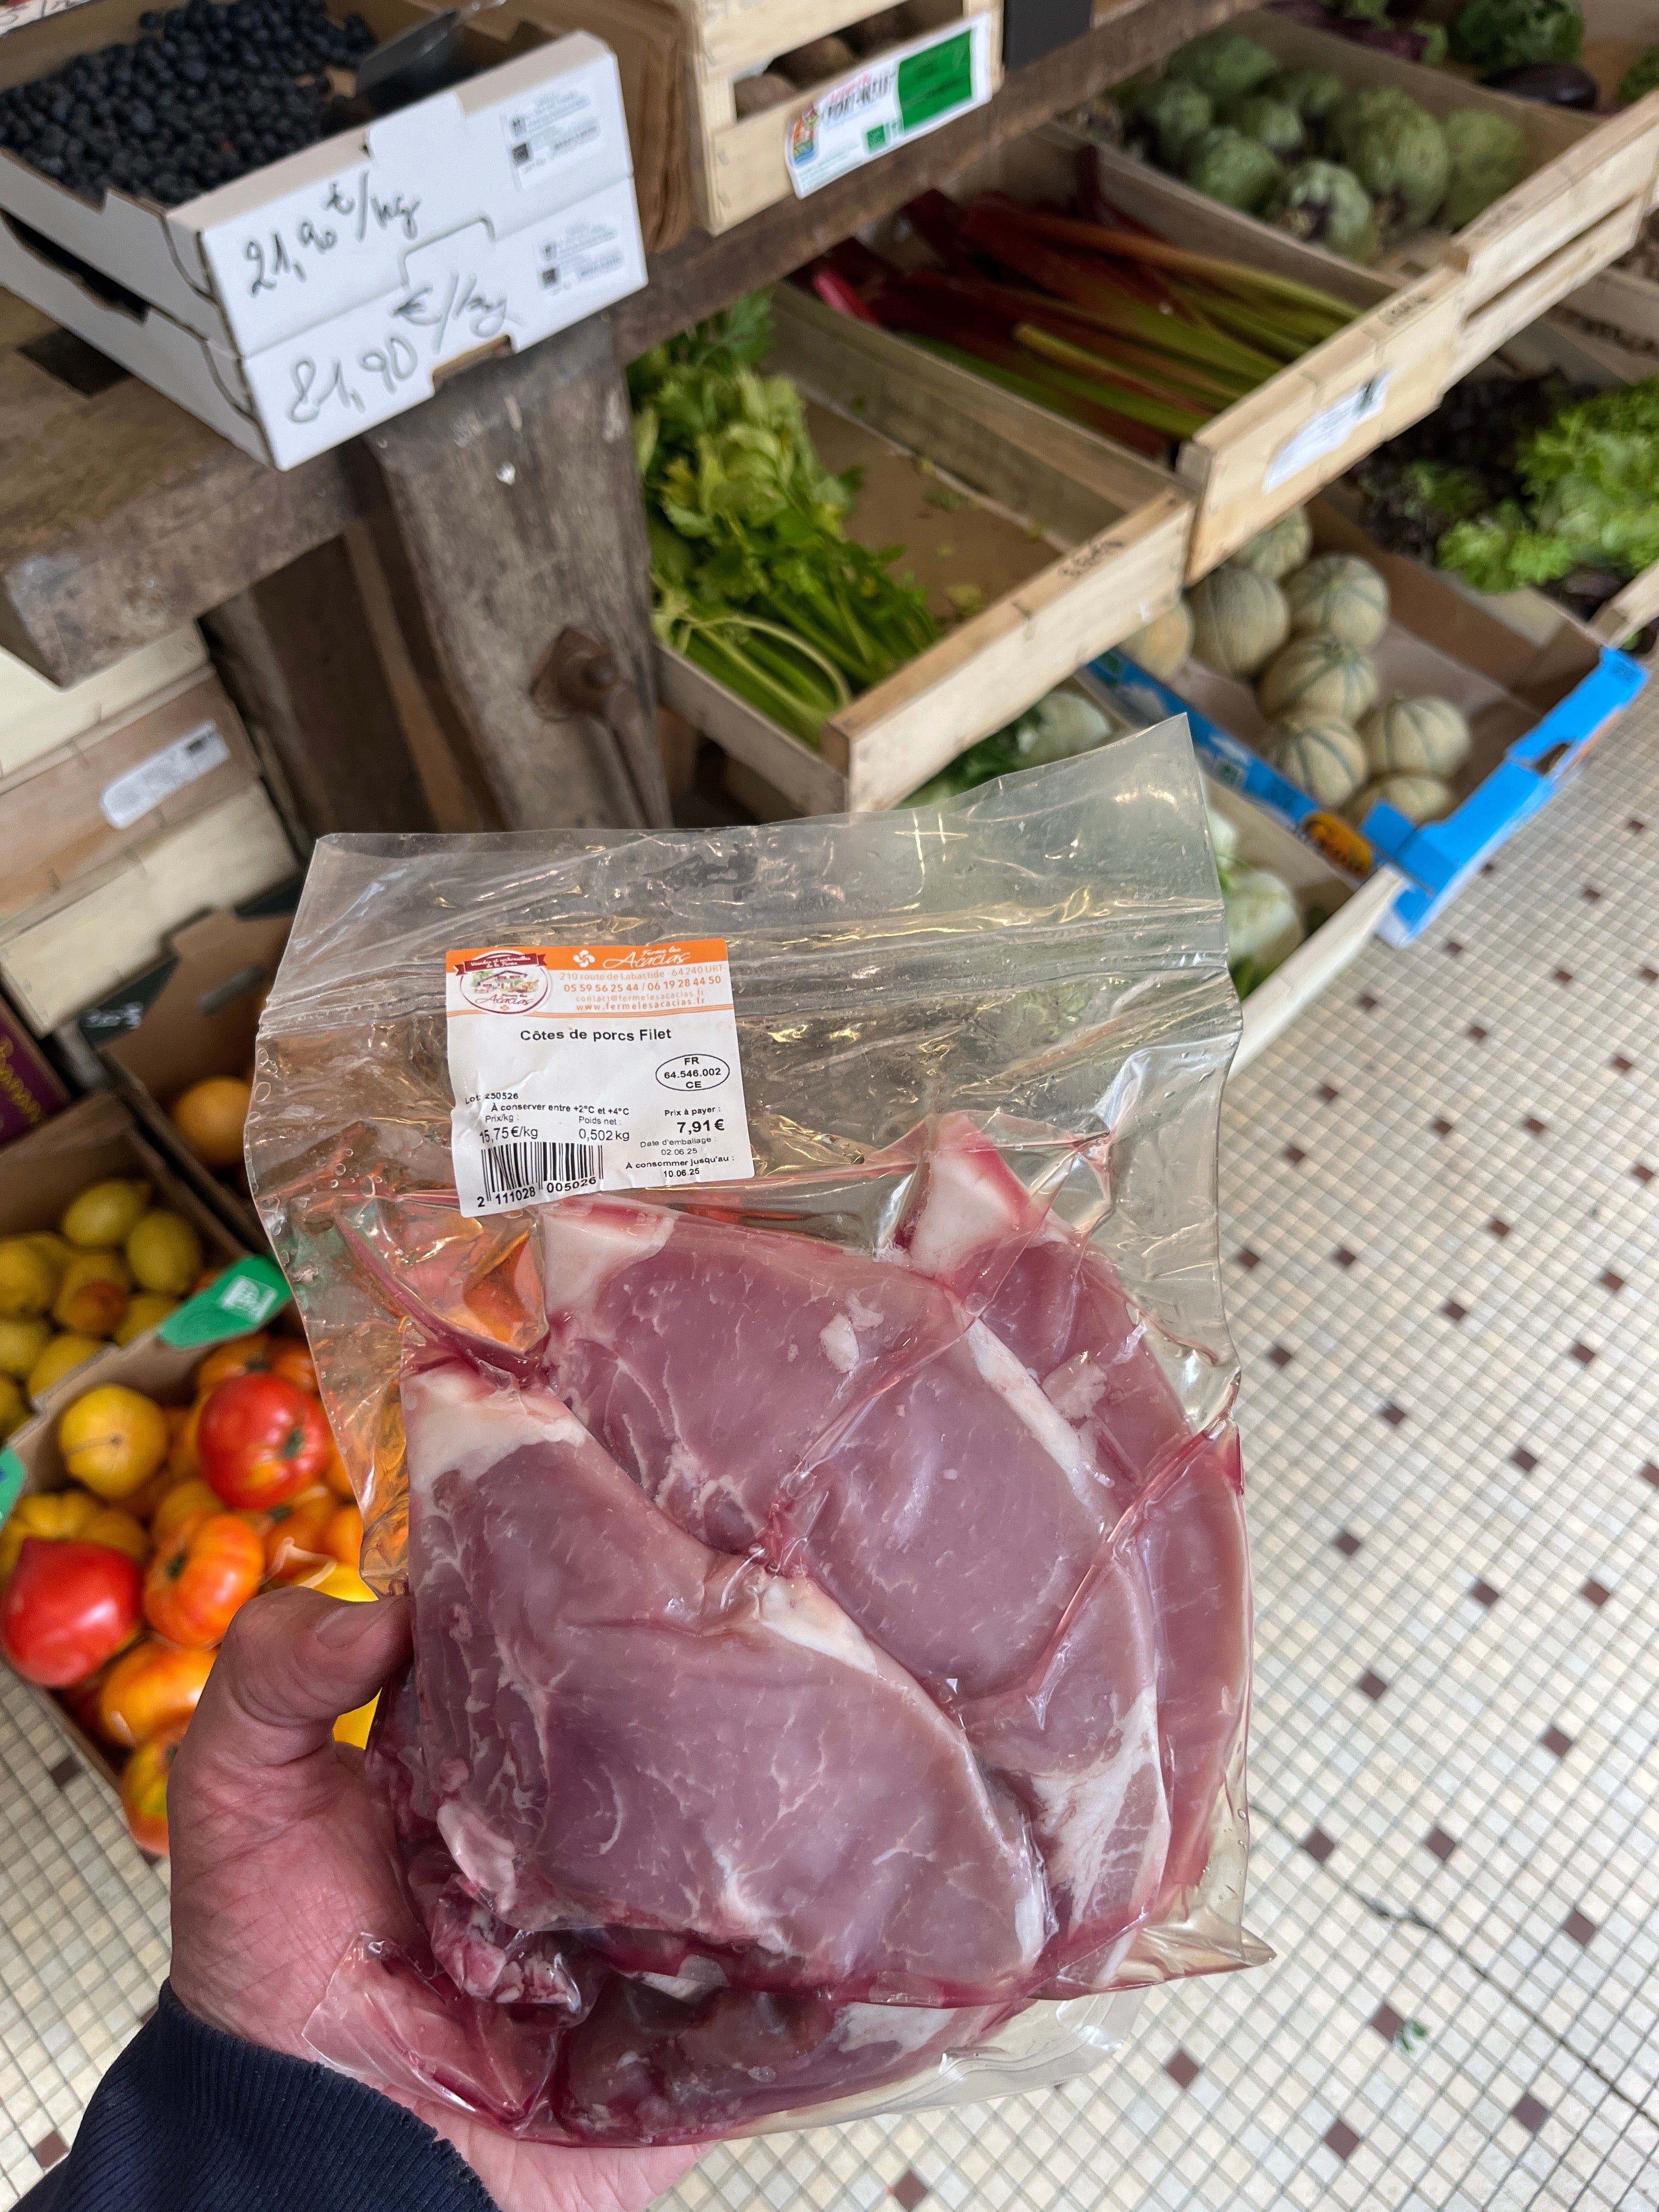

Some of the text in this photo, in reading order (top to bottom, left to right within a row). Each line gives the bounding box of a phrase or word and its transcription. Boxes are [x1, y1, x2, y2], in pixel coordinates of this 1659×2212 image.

[603, 951, 692, 969] Acacias
[560, 972, 578, 980] 210
[621, 969, 665, 980] Labastide
[705, 964, 723, 973] URT
[564, 984, 577, 992] 05
[595, 984, 608, 992] 56
[611, 984, 623, 992] 25
[626, 983, 639, 991] 44
[647, 983, 661, 991] 06
[664, 980, 675, 989] 19
[678, 979, 691, 988] 28
[693, 977, 706, 986] 44
[708, 975, 721, 984] 50
[475, 994, 534, 1006] Acacias
[576, 996, 705, 1011] www.fermelesacacias.fr
[520, 1028, 672, 1042] Côtes de porcs Filet
[684, 1057, 699, 1065] FR
[664, 1068, 721, 1079] 64.546.002
[685, 1081, 702, 1089] CE
[500, 1103, 545, 1111] conserver
[549, 1104, 571, 1112] entre
[574, 1105, 595, 1114] +2°C
[692, 1106, 716, 1116] payer
[485, 1114, 514, 1123] Prix/kg
[579, 1116, 601, 1125] Poids
[662, 1137, 712, 1146] d'emballage
[661, 1148, 698, 1156] 02.06.25
[635, 1160, 689, 1169] consommer
[690, 1156, 729, 1167] jusqu'au
[663, 1167, 700, 1178] 10.06.25
[495, 1186, 536, 1205] 111028
[546, 1176, 597, 1193] 005026
